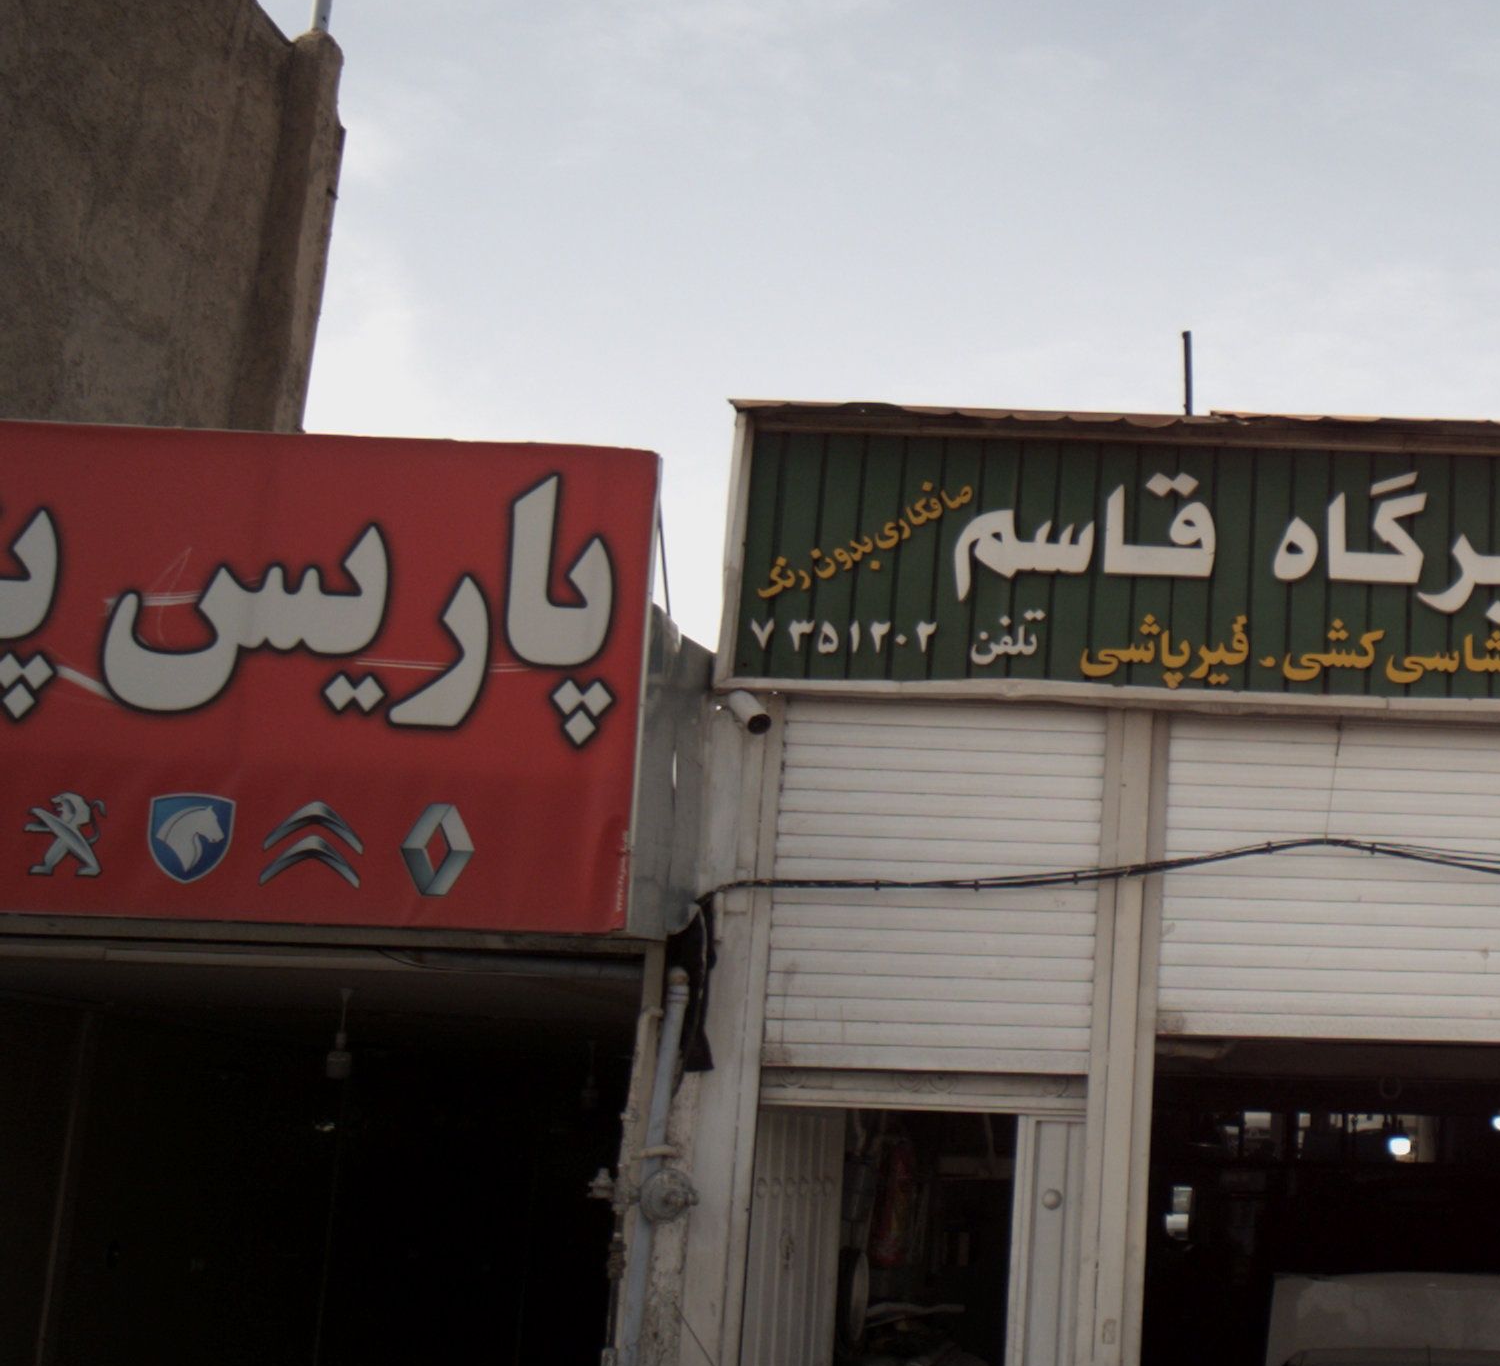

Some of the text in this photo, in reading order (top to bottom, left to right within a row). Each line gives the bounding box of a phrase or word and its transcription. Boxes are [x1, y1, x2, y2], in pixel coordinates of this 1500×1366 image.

[810, 534, 881, 580] بدون
[953, 471, 1217, 602] قاسم
[103, 472, 616, 747] پاریس
[969, 608, 1046, 665] تلفن
